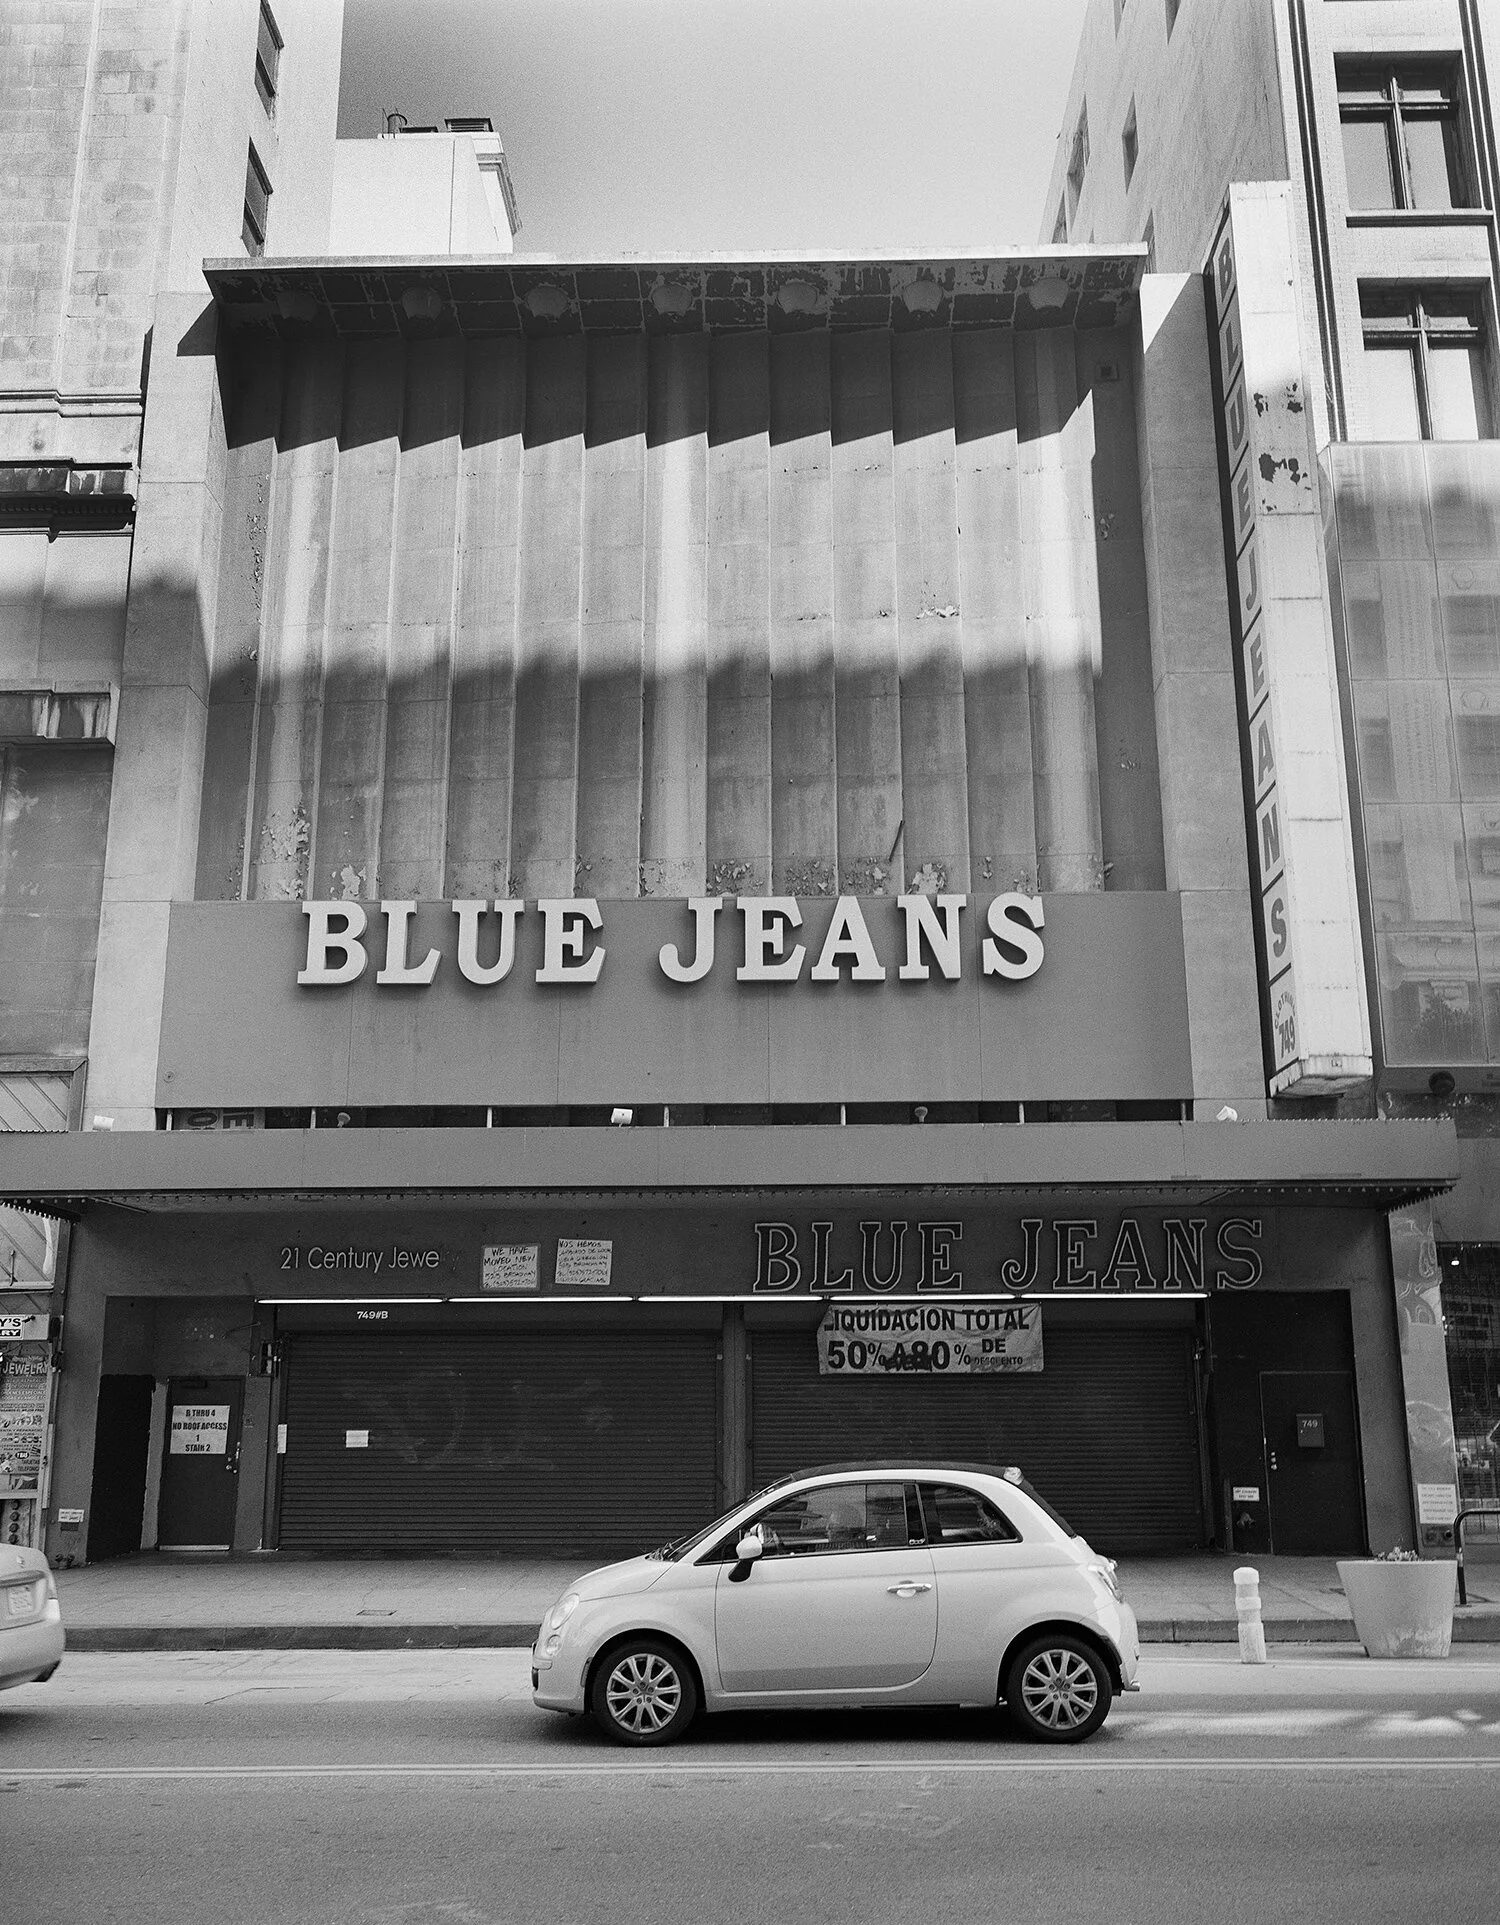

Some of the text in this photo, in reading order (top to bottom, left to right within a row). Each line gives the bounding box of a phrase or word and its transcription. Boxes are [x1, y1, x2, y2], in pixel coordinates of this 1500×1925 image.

[1219, 237, 1250, 534] BLUE
[1246, 546, 1288, 958] JEANS
[297, 892, 1045, 985] BLUE JEANS
[1278, 1015, 1296, 1059] 749
[491, 1246, 530, 1257] WE HAVE
[753, 1218, 1262, 1292] BLUE JEANS
[280, 1246, 440, 1274] 21 Century Jewe
[484, 1253, 536, 1266] MOVED NEW
[356, 1310, 389, 1320] 749#B
[962, 1308, 1030, 1331] TOTAL
[827, 1341, 886, 1370] 50%
[982, 1338, 1007, 1353] DE
[2, 1361, 50, 1375] JEWELRY
[192, 1409, 210, 1417] THRU
[210, 1409, 216, 1417] 4
[172, 1422, 228, 1430] NO ROOF ACCESS
[1301, 1419, 1319, 1428] 749
[196, 1434, 200, 1442] 1
[205, 1444, 211, 1452] 2
